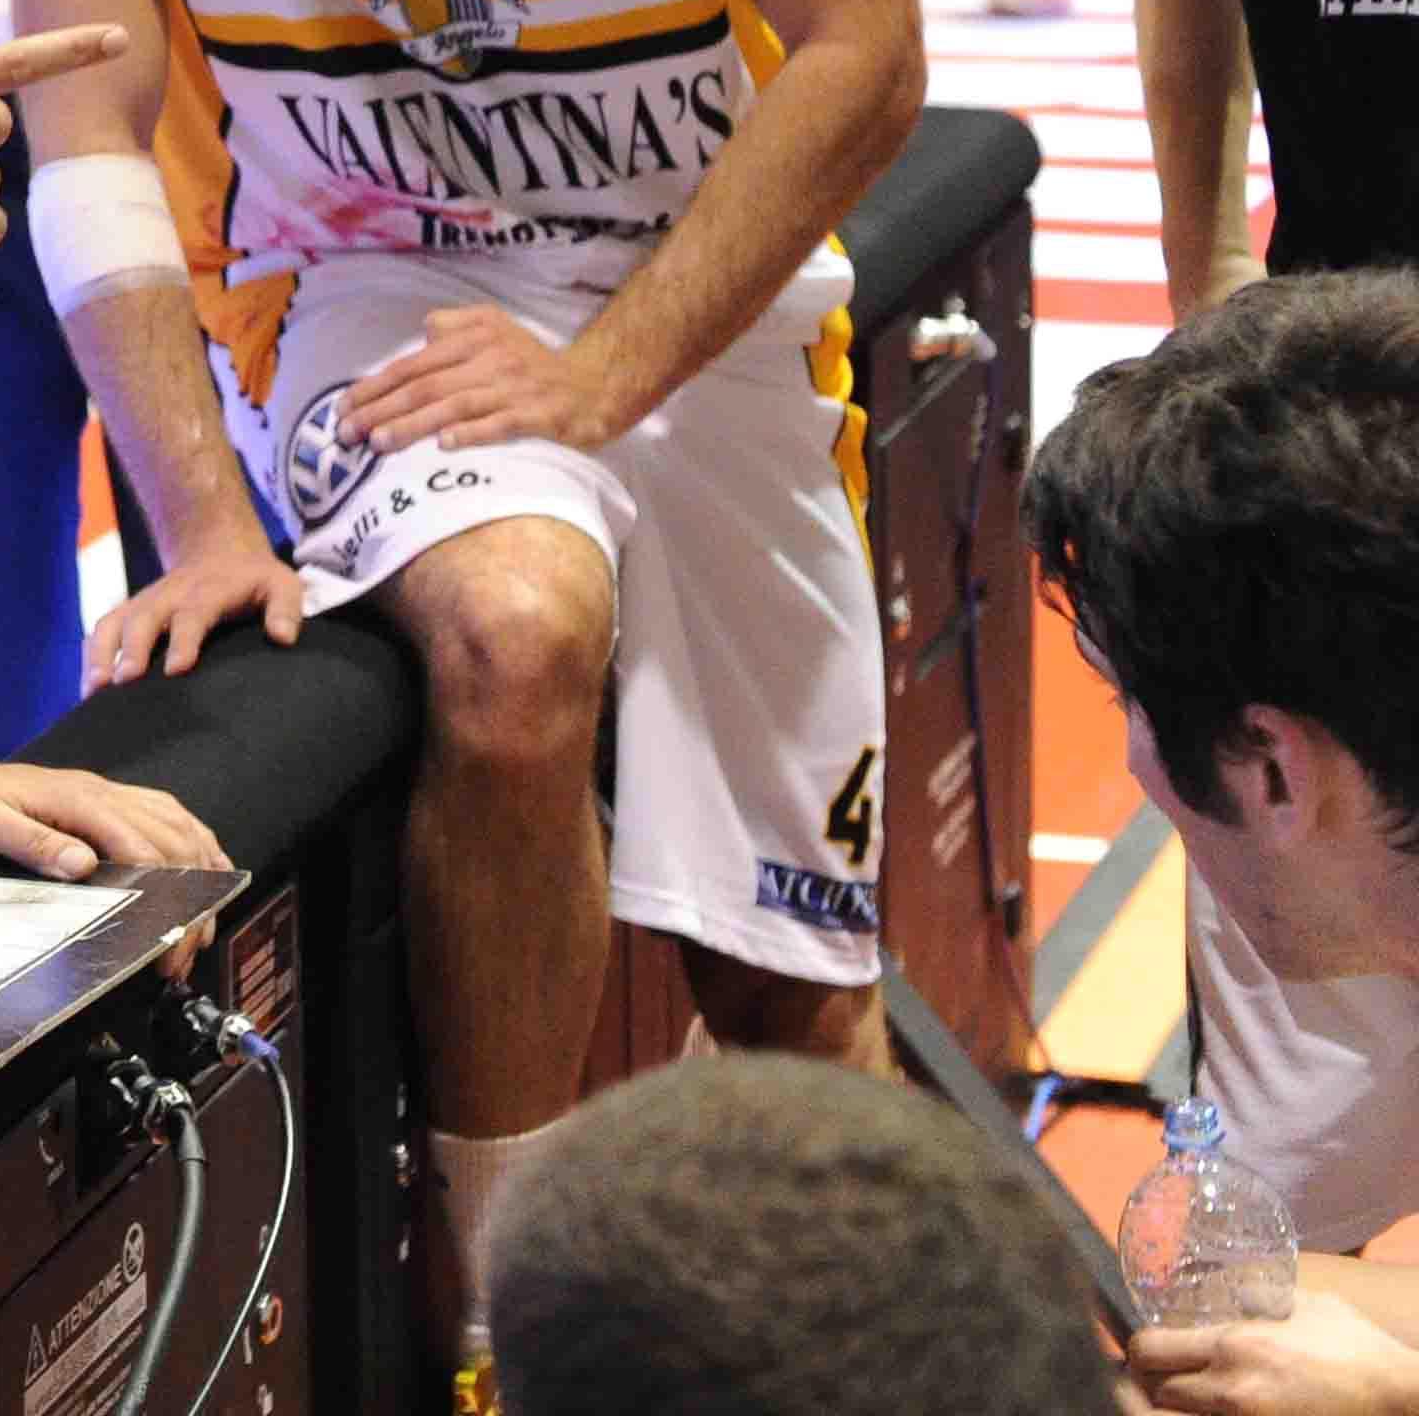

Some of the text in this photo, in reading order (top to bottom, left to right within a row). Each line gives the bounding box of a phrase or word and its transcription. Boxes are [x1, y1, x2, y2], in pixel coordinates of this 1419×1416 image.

[279, 66, 734, 201] VALENTINA'S
[390, 487, 416, 515] &
[426, 468, 492, 493] Co.
[822, 745, 876, 869] 4
